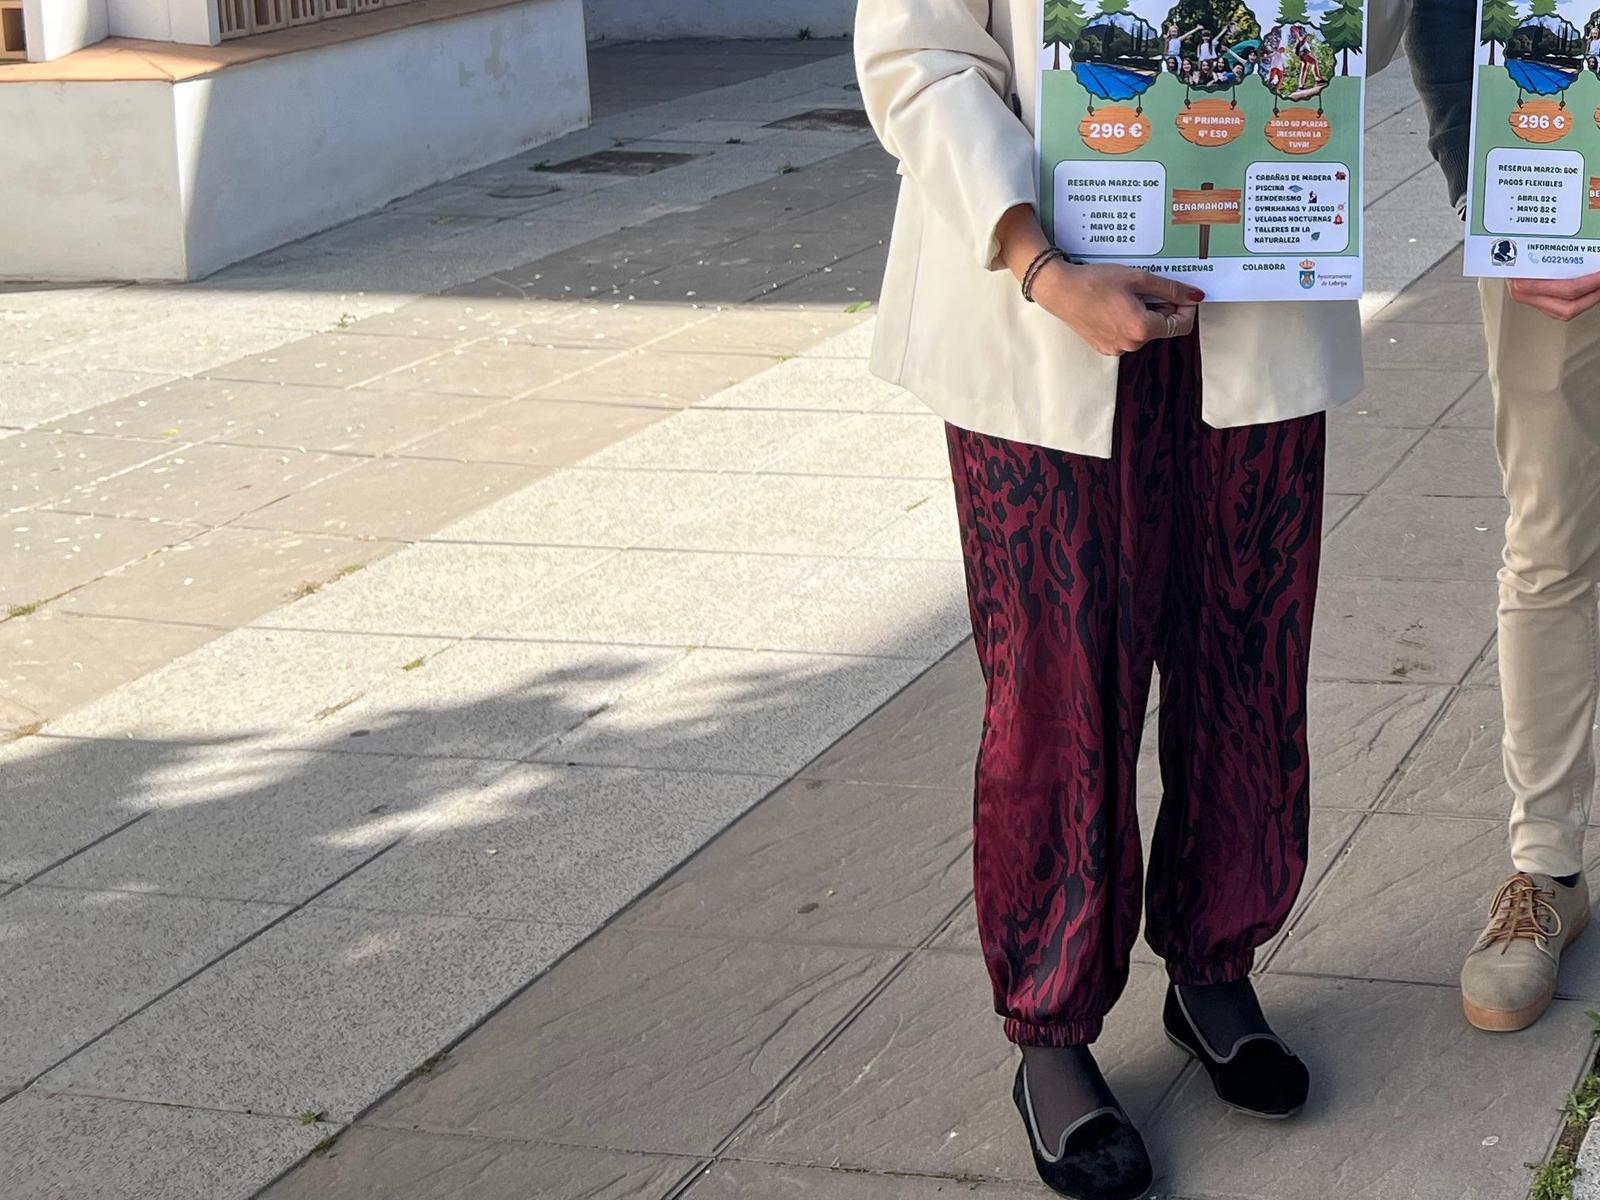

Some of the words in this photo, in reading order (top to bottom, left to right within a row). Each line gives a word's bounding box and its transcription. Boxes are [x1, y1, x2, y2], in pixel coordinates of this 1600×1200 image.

[1301, 120, 1328, 128] PLAZAS
[1518, 115, 1550, 129] 296
[1553, 115, 1565, 129] €
[1090, 123, 1126, 138] 296
[1129, 123, 1143, 138] €
[1210, 130, 1228, 138] ESO
[1534, 166, 1562, 174] MARZO:
[1256, 173, 1290, 181] CABAÑAS
[1067, 179, 1107, 187] RESERVA
[1108, 179, 1141, 187] MARZO:
[1068, 194, 1096, 202] PAGOS
[1099, 194, 1142, 202] FLEXIBLES
[1517, 194, 1539, 202] ABRIL
[1173, 202, 1238, 211] BENAMAHOMA
[1527, 244, 1579, 252] INFORMACIÓN
[1541, 255, 1584, 264] 602216985
